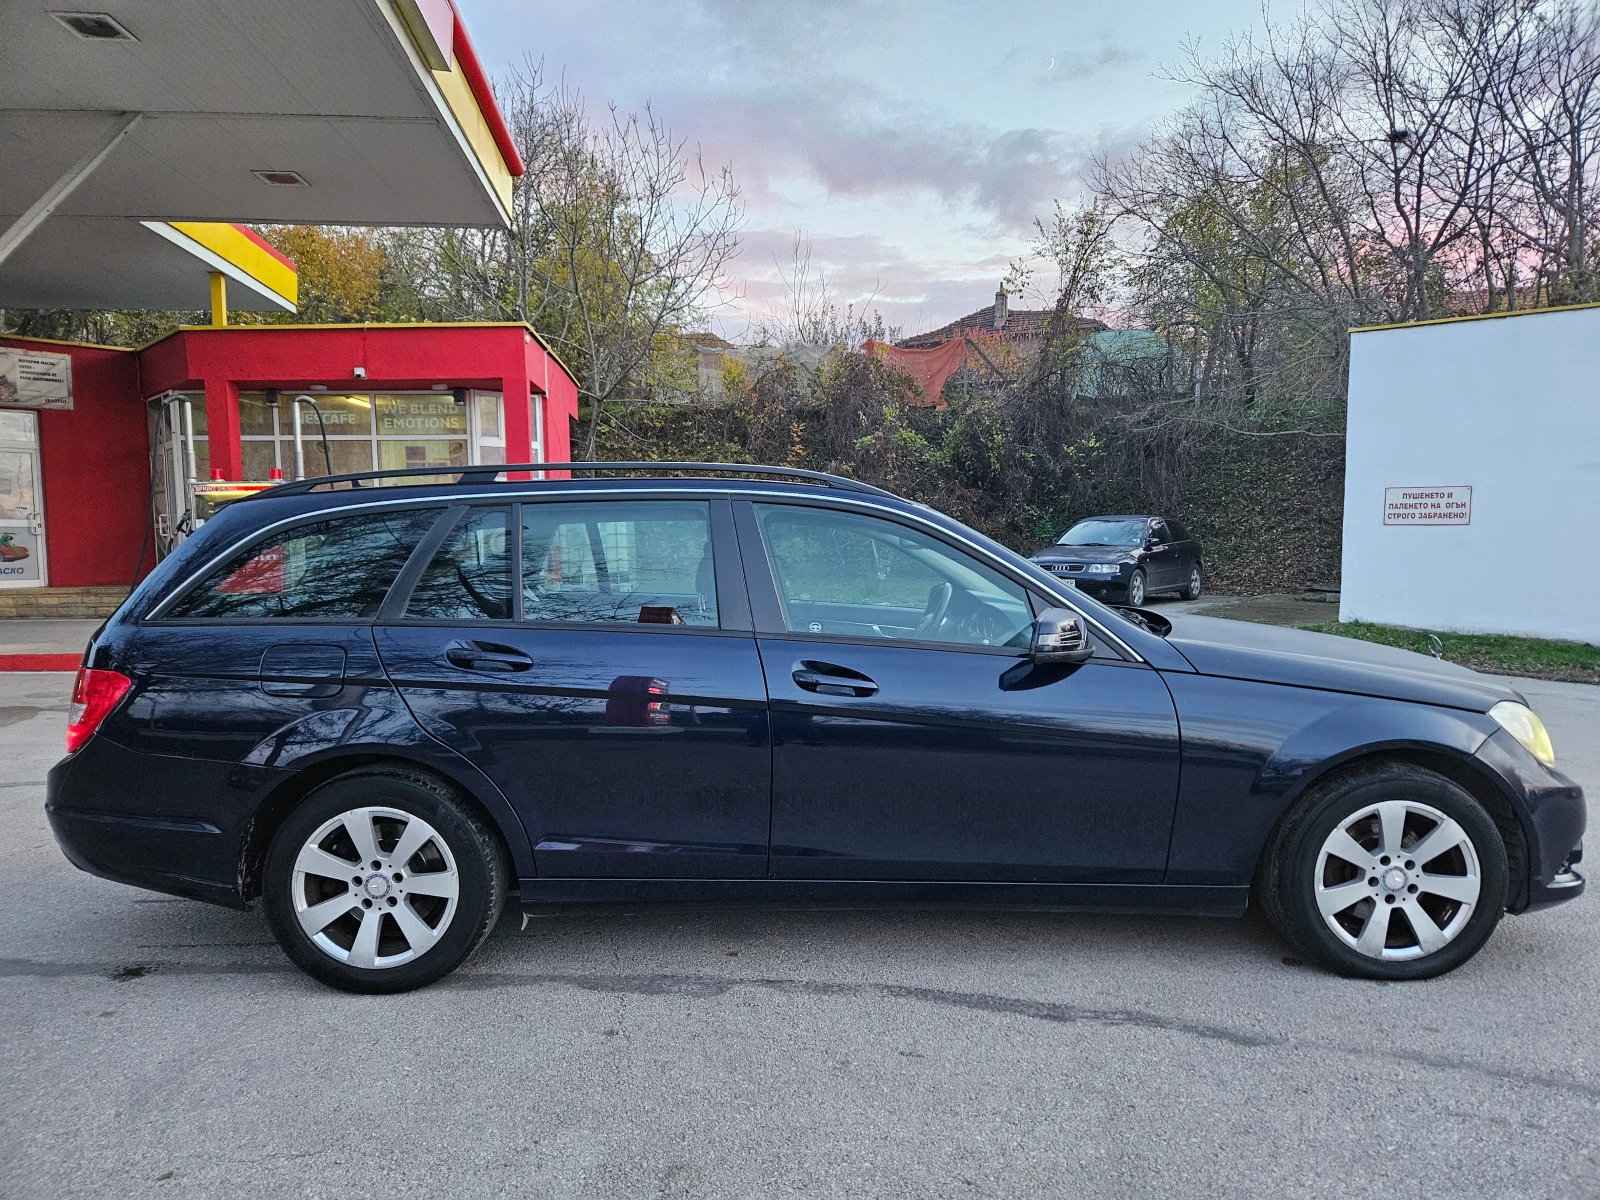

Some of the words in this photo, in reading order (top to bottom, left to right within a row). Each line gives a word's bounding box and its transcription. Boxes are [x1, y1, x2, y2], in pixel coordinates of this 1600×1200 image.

[383, 404, 407, 414] WE
[410, 404, 459, 414] BLEND
[384, 417, 460, 429] EMOTIONS
